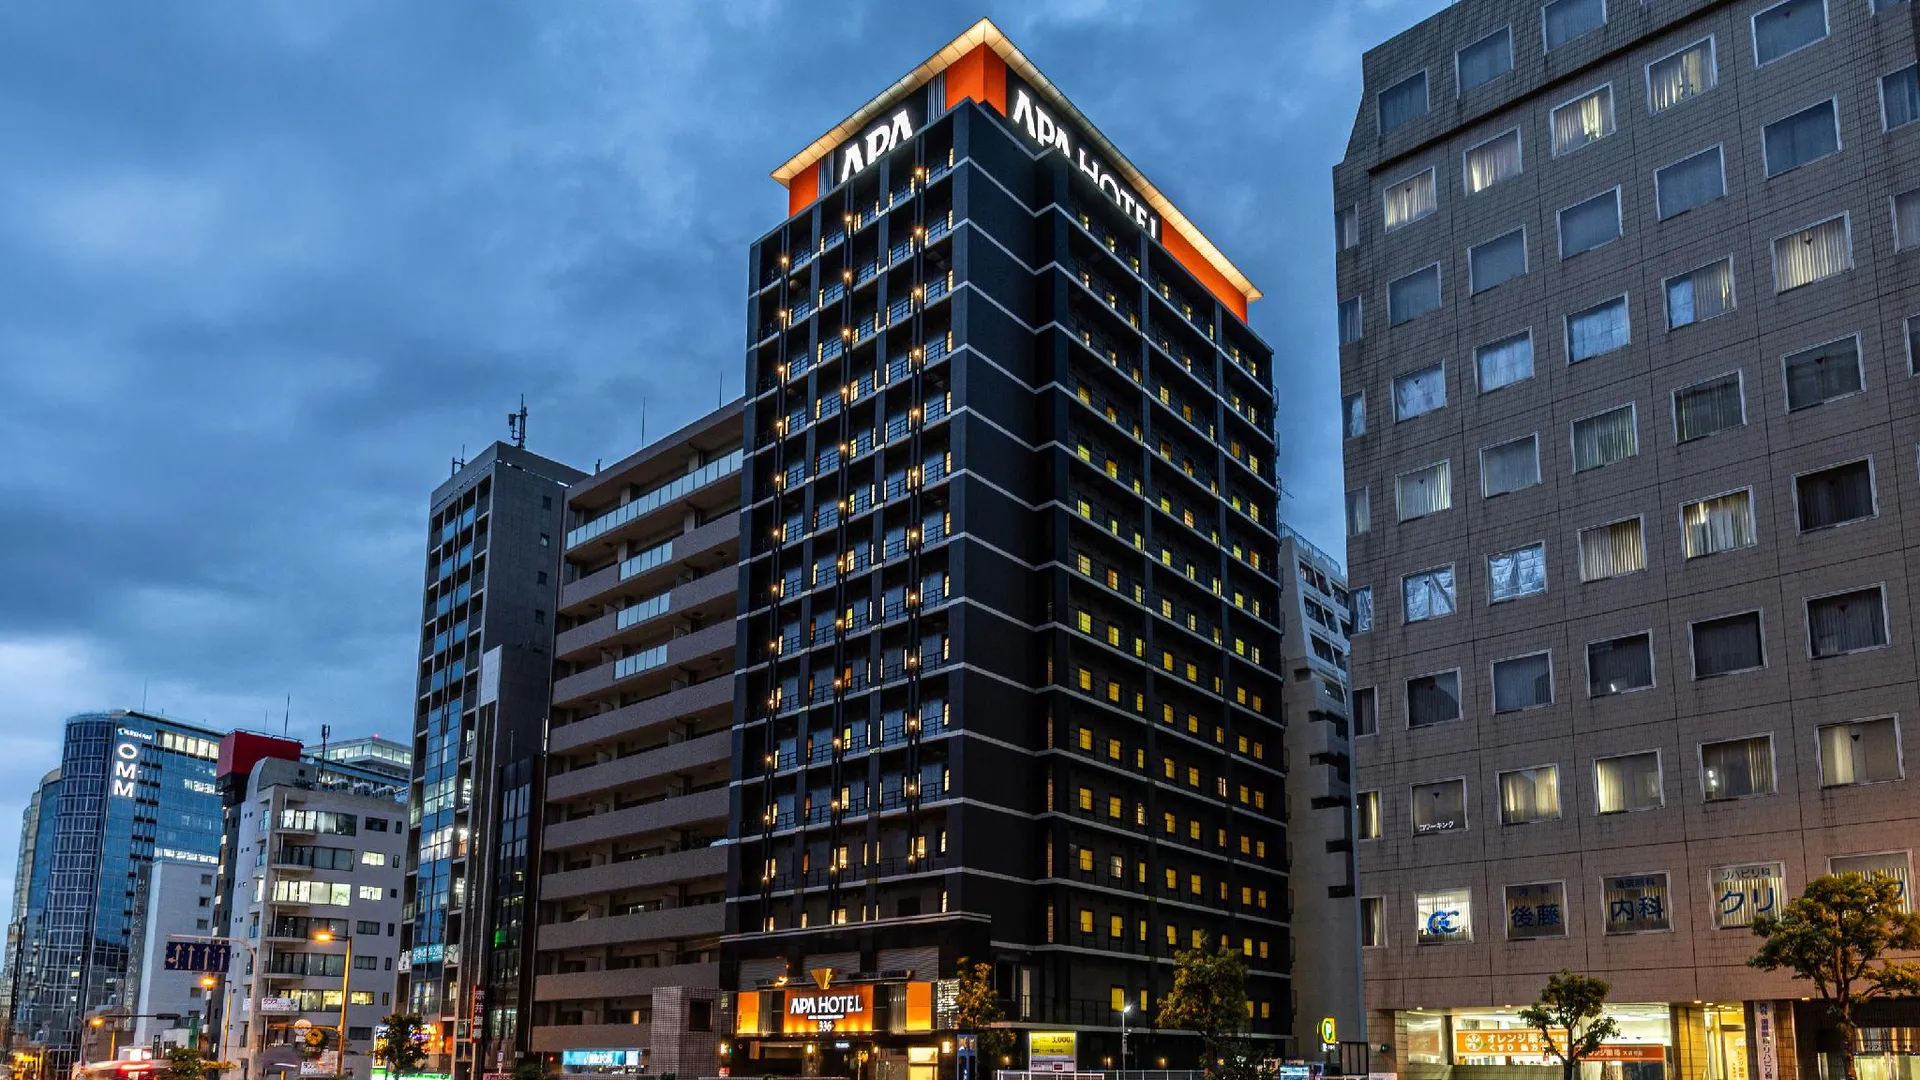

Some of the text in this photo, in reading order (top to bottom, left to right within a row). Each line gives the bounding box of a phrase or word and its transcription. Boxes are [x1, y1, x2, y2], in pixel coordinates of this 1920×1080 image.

[1012, 89, 1070, 158] APA
[840, 109, 913, 183] APA
[114, 743, 138, 797] OMM
[1721, 867, 1771, 880] リハビリ科
[1511, 904, 1561, 927] 後藤
[1611, 896, 1663, 921] 内科
[790, 994, 863, 1014] APA HOTEL
[1325, 1022, 1332, 1040] P
